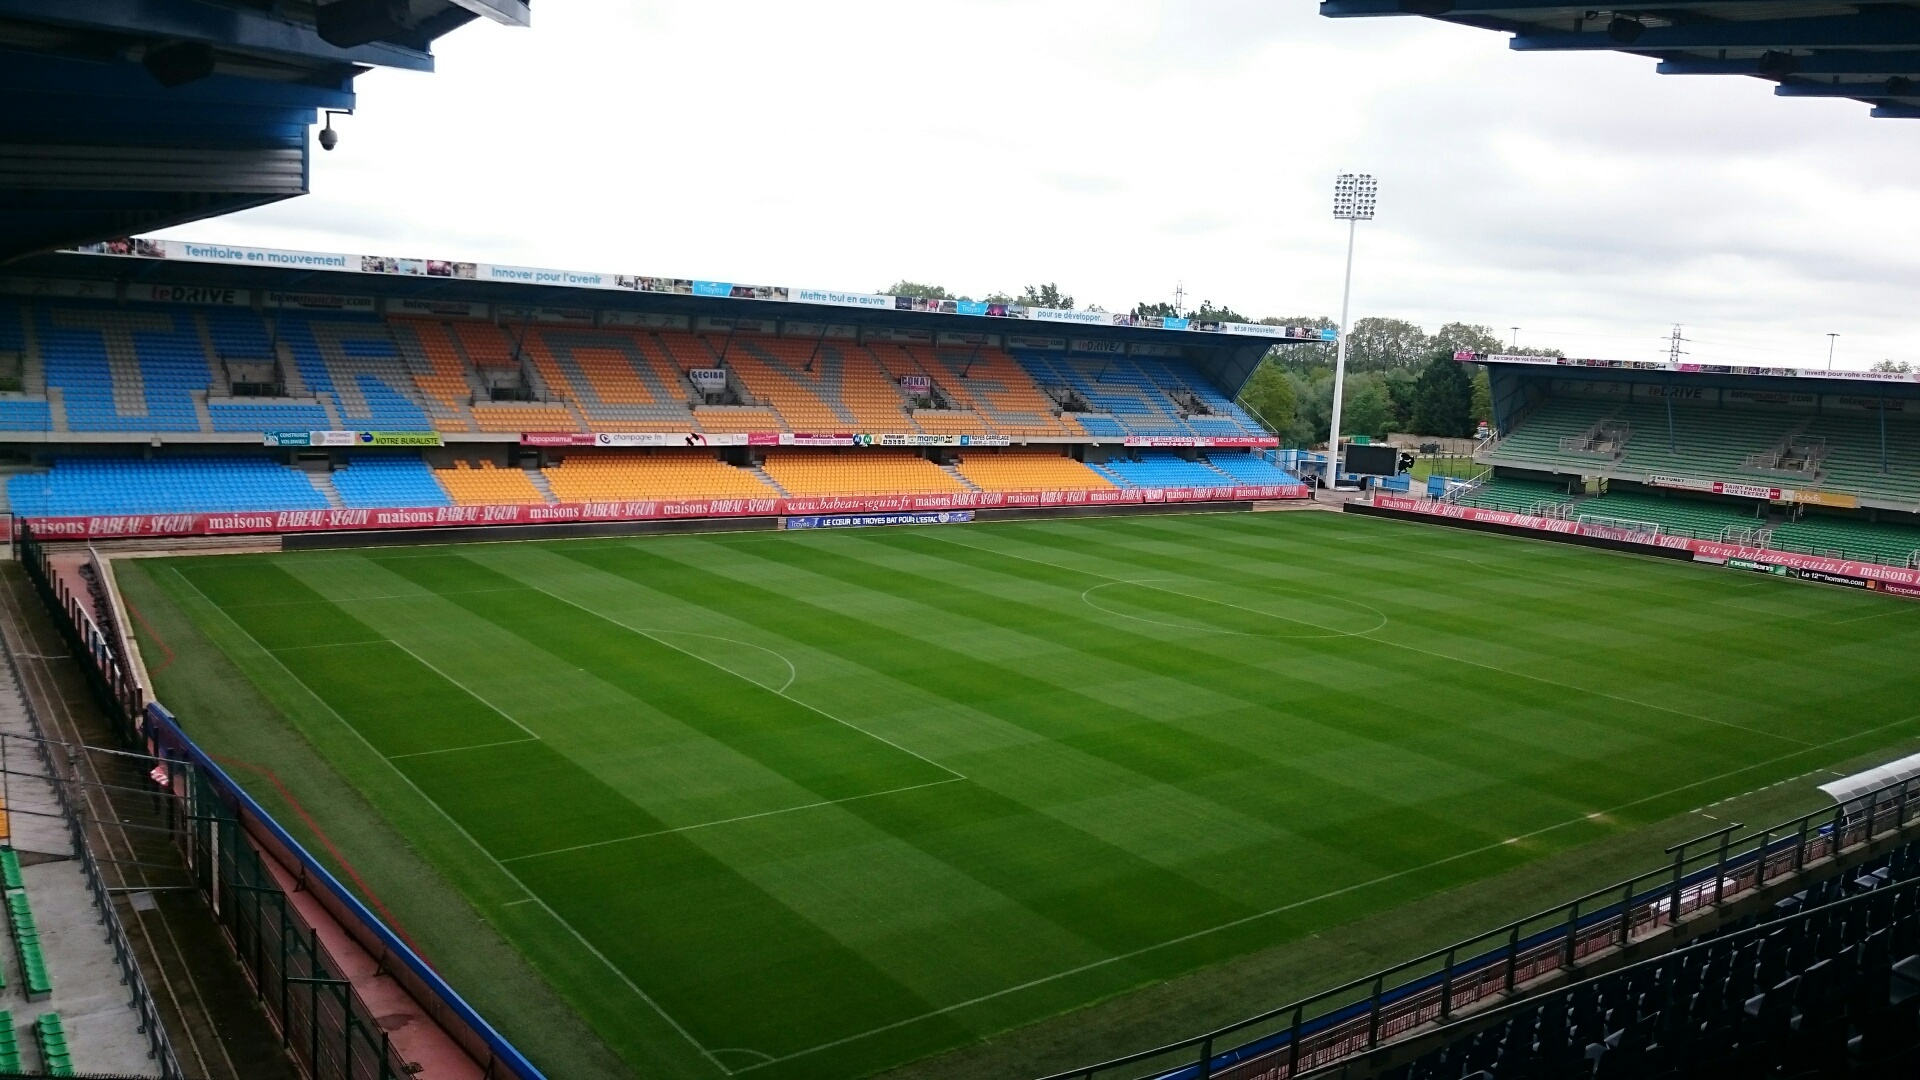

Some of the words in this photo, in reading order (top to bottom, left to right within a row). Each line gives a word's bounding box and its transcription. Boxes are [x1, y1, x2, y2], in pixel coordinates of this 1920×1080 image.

[184, 244, 243, 261] Territoire
[247, 252, 264, 262] en
[268, 252, 345, 267] mouvement
[492, 266, 532, 280] Innover
[535, 272, 560, 284] pour
[563, 273, 602, 285] l'avenir
[800, 290, 827, 302] Mettre
[828, 292, 845, 302] tout
[1037, 311, 1053, 321] pour
[691, 370, 724, 379] GECIBA
[1804, 370, 1827, 378] Investir
[376, 437, 400, 445] VOTRE
[401, 437, 438, 445] BURALISTE
[527, 434, 572, 444] hippopotamus
[614, 432, 652, 442] champagne
[917, 434, 945, 444] mangin
[1091, 491, 1119, 501] maisons
[1167, 489, 1192, 499] maisons
[1236, 487, 1260, 497] maisons
[1740, 490, 1768, 498] TERTRES
[915, 496, 951, 508] maisons
[1007, 492, 1039, 504] maisons
[1381, 498, 1412, 509] maisons
[663, 500, 708, 515] maisons
[787, 496, 911, 513] www.babeau-seguin.fr
[377, 508, 434, 524] maisons
[529, 503, 579, 519] maisons
[209, 513, 272, 529] maisons
[823, 518, 832, 526] LE
[852, 517, 862, 525] DE
[862, 517, 886, 525] TROYES
[886, 516, 898, 524] BAT
[899, 515, 916, 524] POUR
[915, 515, 938, 524] L'ESTAC
[1475, 511, 1510, 523] maisons
[1583, 527, 1622, 541] maisons
[1698, 543, 1853, 575] www.babeau-seguin.fr
[1860, 566, 1913, 583] maisons
